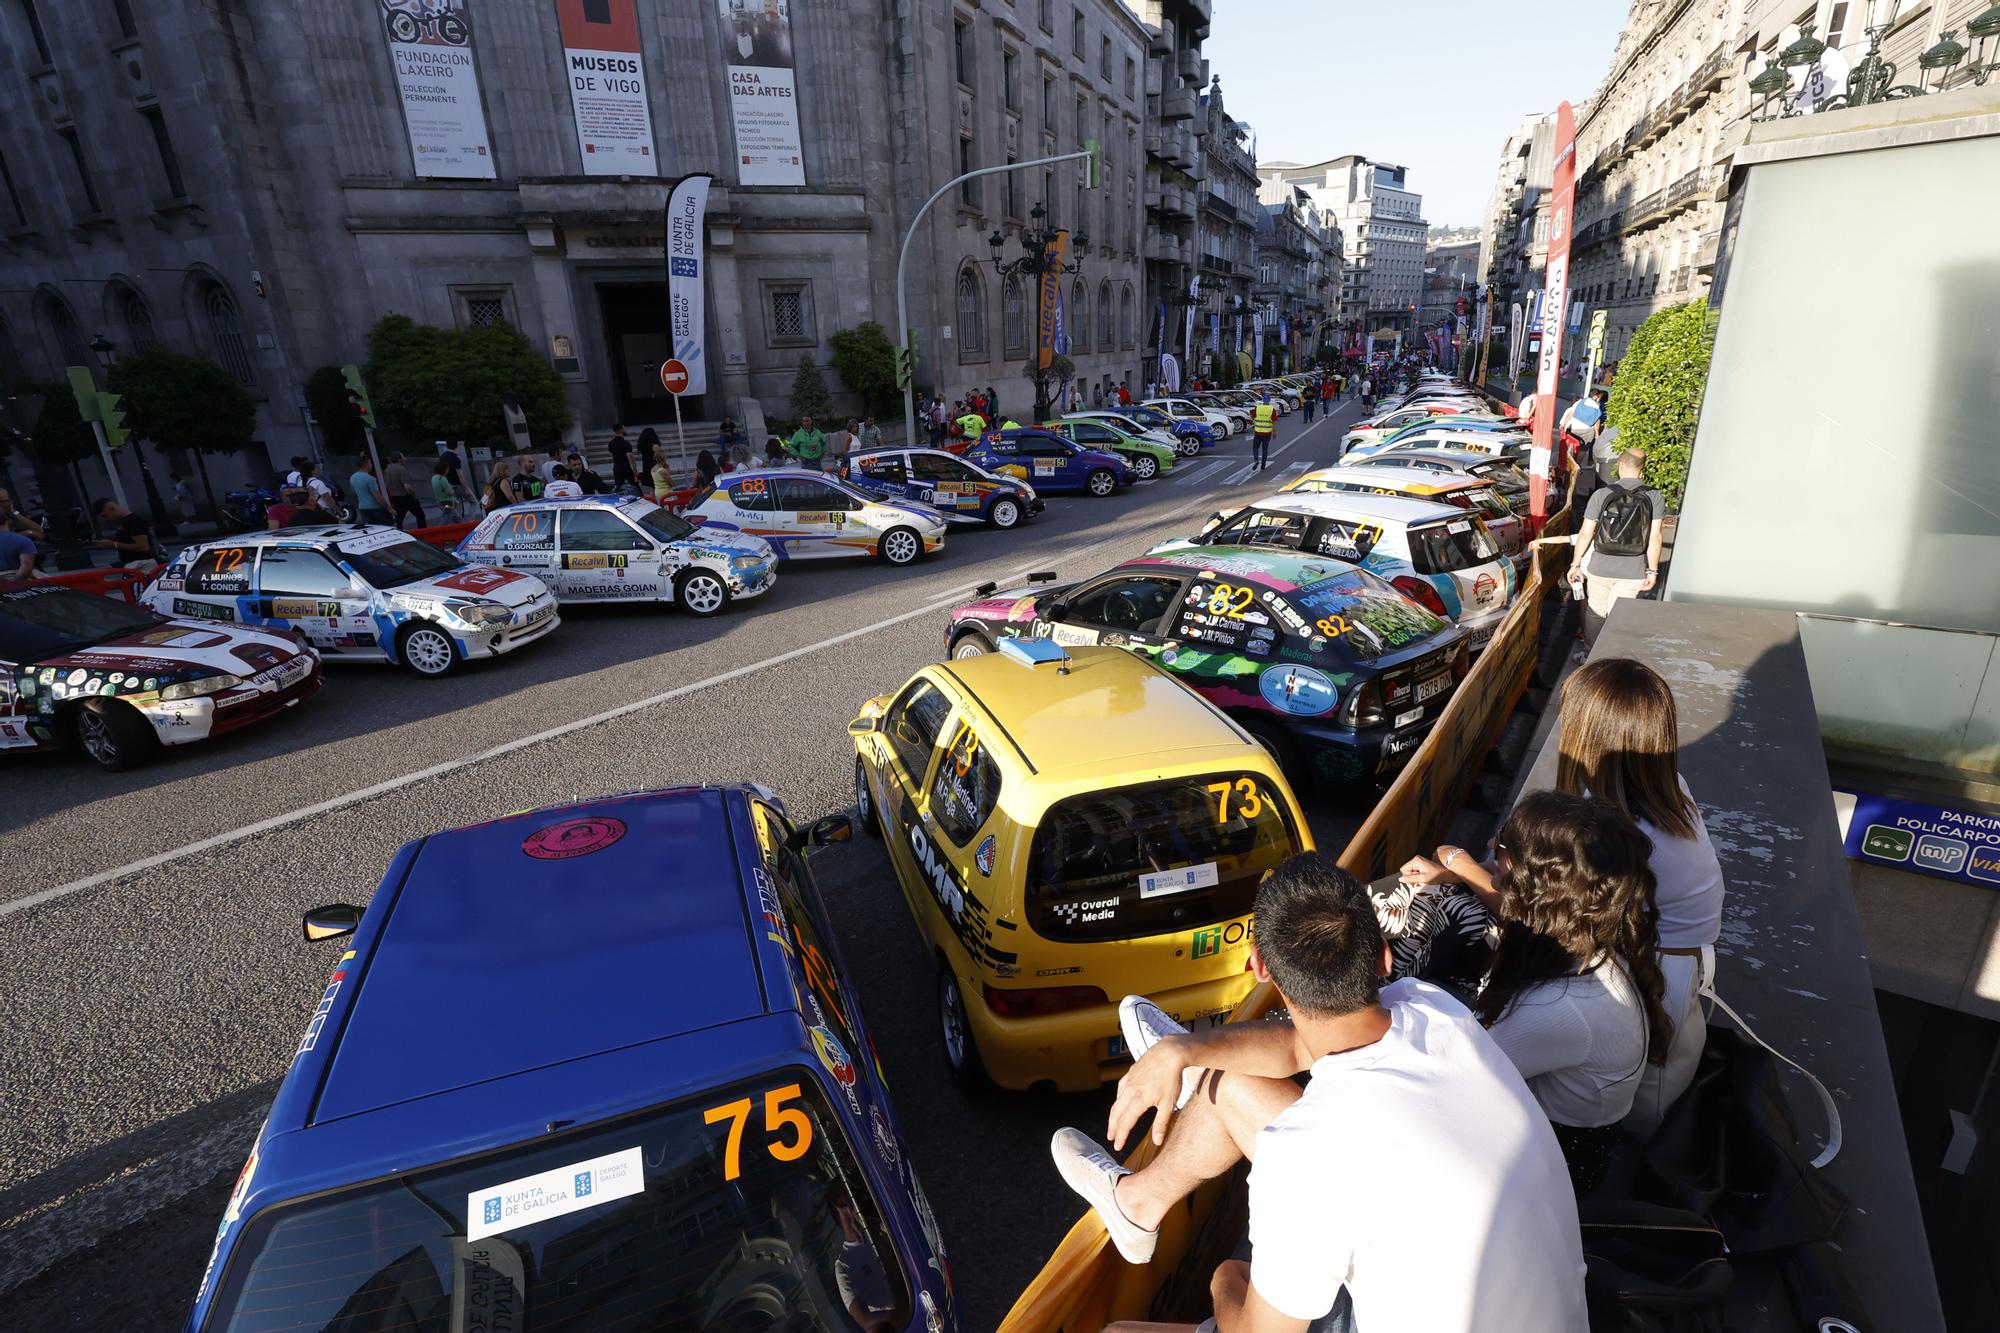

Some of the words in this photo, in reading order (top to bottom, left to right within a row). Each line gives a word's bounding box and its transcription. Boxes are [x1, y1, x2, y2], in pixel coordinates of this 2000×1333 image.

[396, 51, 469, 65] FUNDACIÓN
[571, 56, 637, 73] MUSEOS
[399, 64, 453, 77] LAXEIRO
[575, 77, 596, 90] DE
[604, 79, 640, 93] VIGO
[732, 73, 760, 83] CASA
[403, 85, 446, 93] COLECCIÓN
[733, 86, 754, 95] DAS
[757, 87, 791, 97] ARTES
[405, 94, 456, 103] PERMANENTE
[684, 196, 696, 239] GALICIA
[673, 216, 683, 254] XUNTA
[685, 241, 694, 255] DE
[742, 478, 765, 492] 68
[965, 483, 974, 492] 66
[511, 513, 537, 532] 70
[800, 513, 826, 521] Recalvi
[832, 512, 843, 523] 68
[1260, 515, 1272, 526] 69
[213, 548, 244, 572] 72
[572, 557, 604, 566] Recalvi
[611, 555, 625, 567] 70
[201, 573, 209, 581] A.
[211, 571, 243, 581] MUIÑOS
[160, 581, 180, 590] ROCHA
[201, 583, 209, 591] T.
[211, 583, 240, 591] CONDE
[568, 585, 621, 595] MADERAS
[623, 584, 657, 592] GOIAN
[1208, 584, 1254, 619] 82
[277, 604, 314, 614] Recalvi
[321, 602, 337, 617] 72
[1036, 621, 1050, 637] 82
[1316, 615, 1353, 637] 82
[1057, 629, 1094, 647] Recalvi
[1280, 646, 1313, 661] Maderas
[1420, 679, 1439, 699] 2878
[947, 715, 979, 777] 73
[1390, 735, 1420, 754] Mesón
[936, 776, 956, 818] M.Puga
[952, 775, 977, 820] Martínez
[1207, 777, 1262, 824] 73
[1897, 817, 2000, 845] POLICARPO
[911, 823, 964, 926] OMR
[1164, 880, 1185, 888] GALICIA
[1081, 896, 1120, 910] Overall
[1082, 909, 1115, 922] Media
[1038, 967, 1070, 976] OMR
[1202, 1004, 1233, 1016] Concello
[703, 1083, 813, 1182] 75
[600, 1162, 628, 1176] DEPORTE
[600, 1170, 627, 1183] GALEGO
[505, 1186, 544, 1204] XUNTA
[504, 1204, 520, 1217] DE
[523, 1191, 568, 1211] GALICIA
